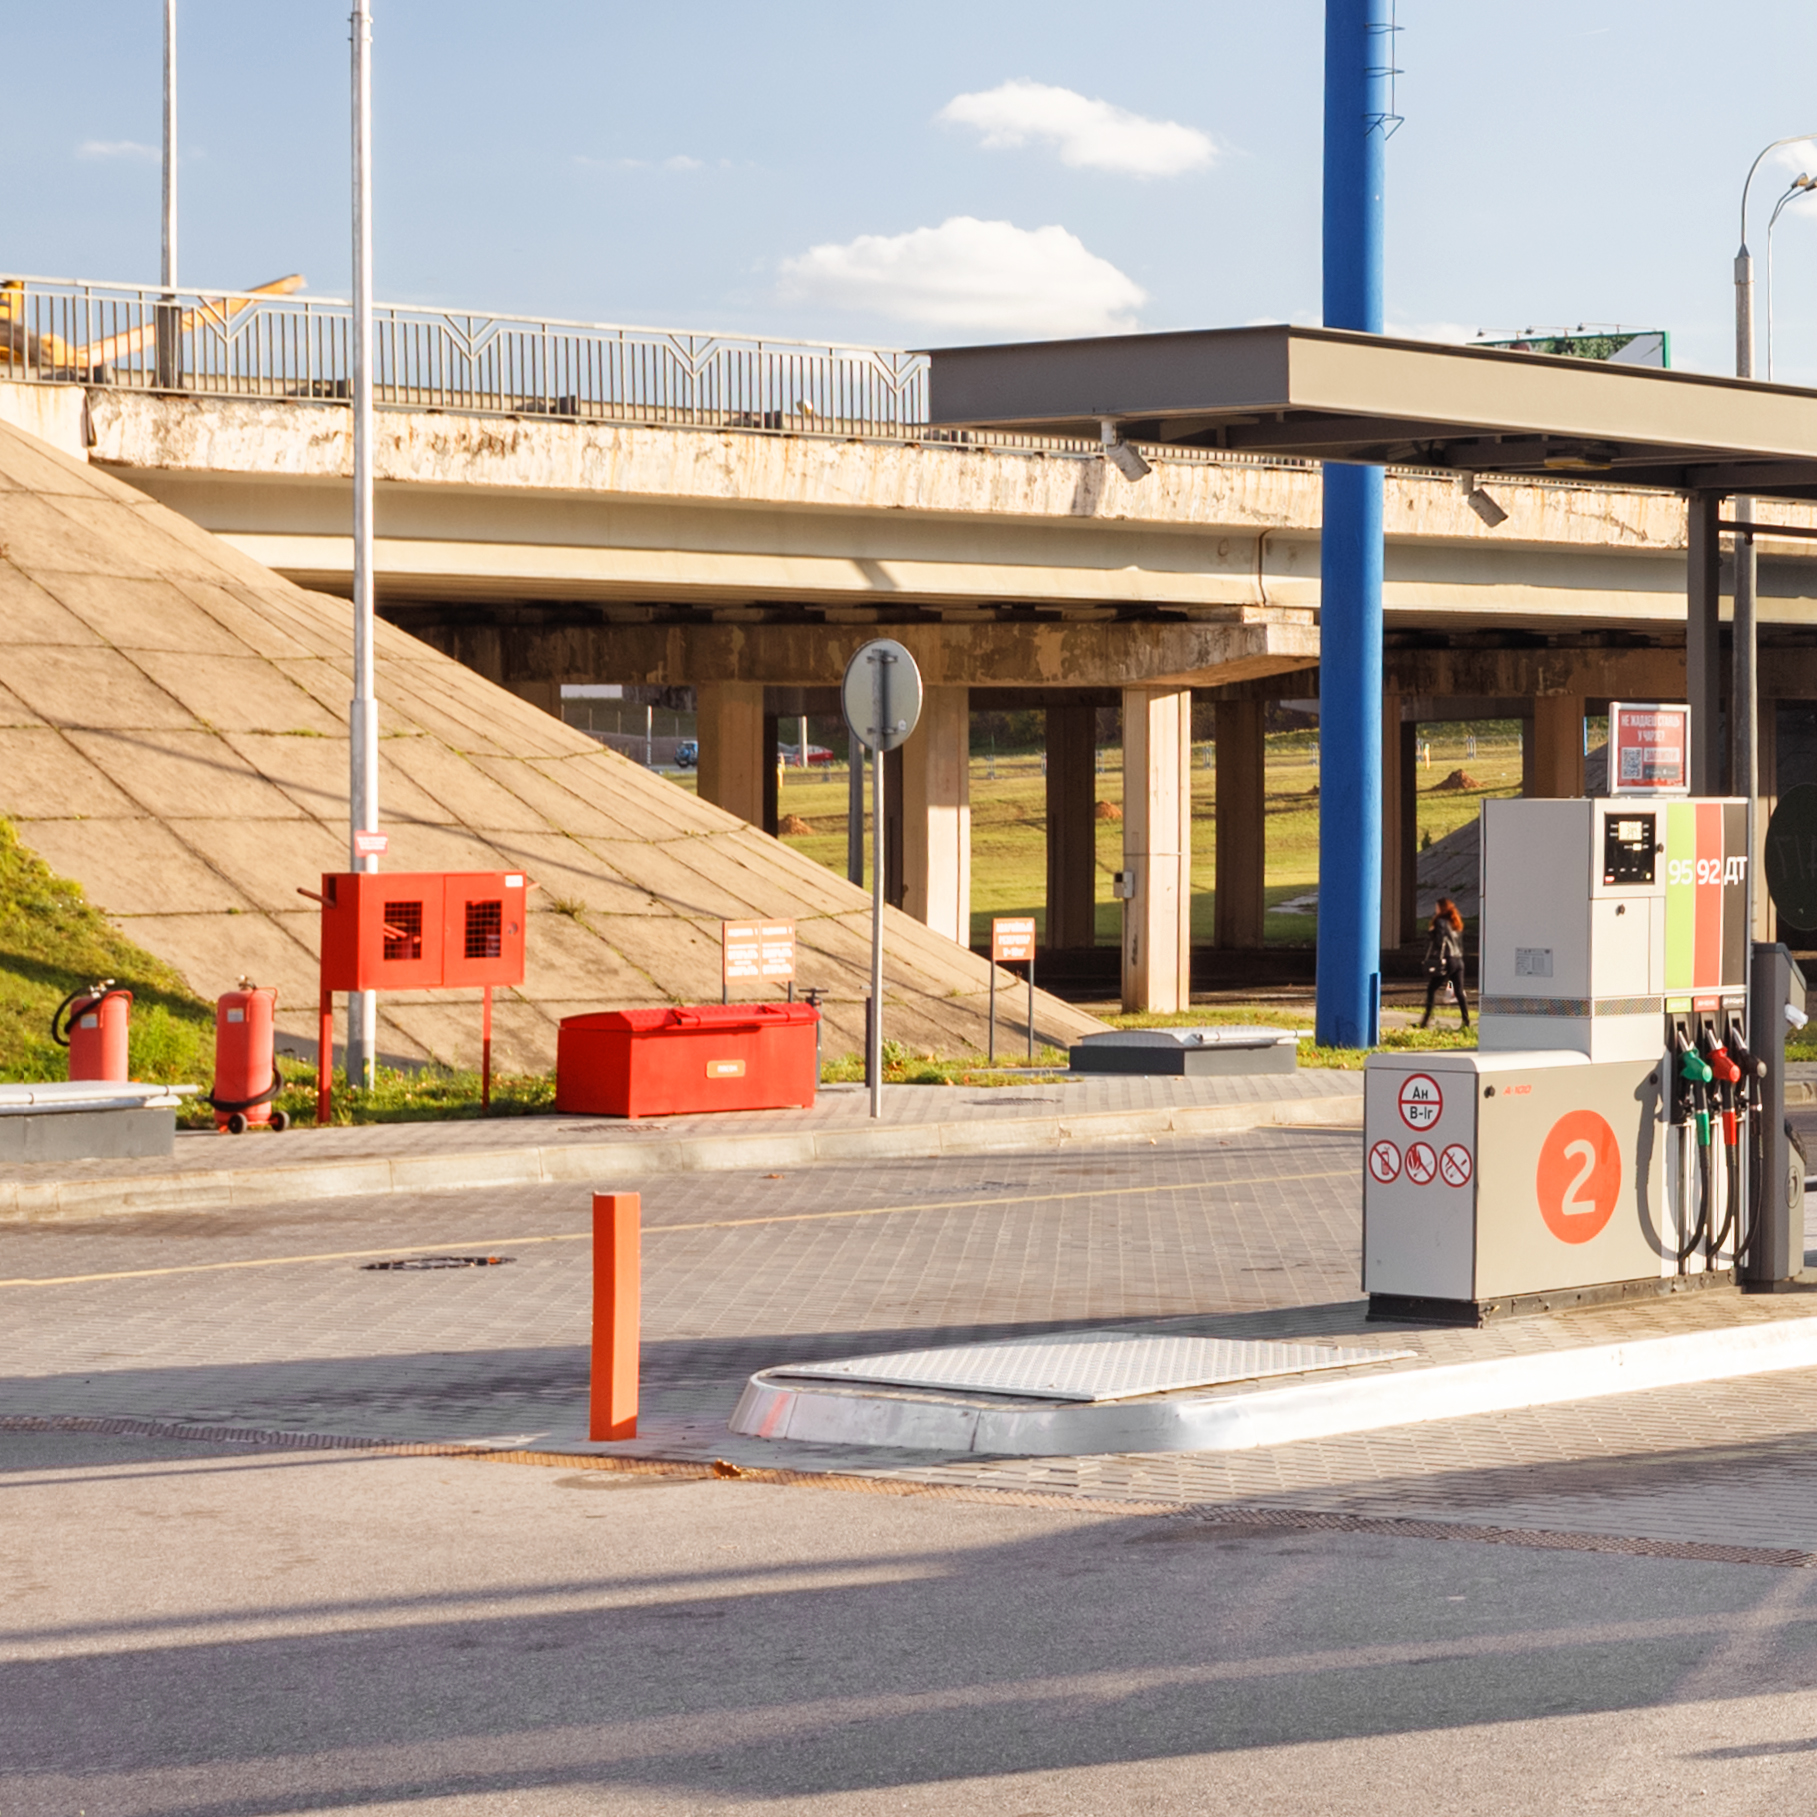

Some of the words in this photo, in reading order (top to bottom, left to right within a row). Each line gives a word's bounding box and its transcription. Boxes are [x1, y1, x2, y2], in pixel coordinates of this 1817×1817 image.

[1668, 859, 1693, 885] 95
[1696, 859, 1721, 885] 92
[1723, 856, 1748, 886] ДТ
[1412, 1086, 1429, 1100] Ан
[1561, 1138, 1596, 1216] 2
